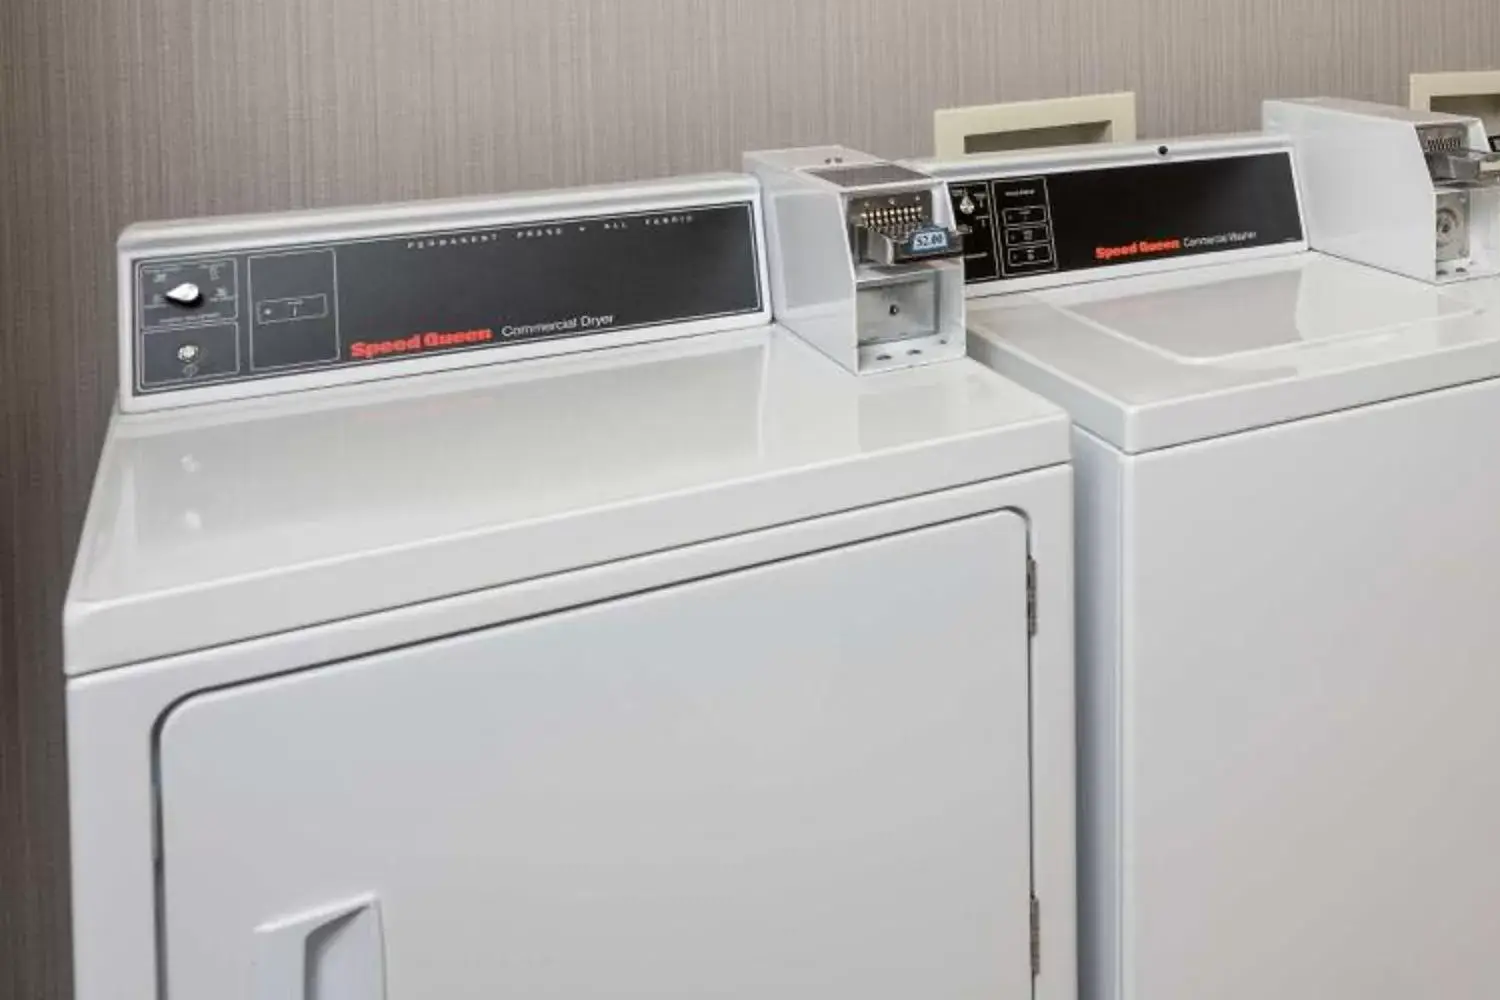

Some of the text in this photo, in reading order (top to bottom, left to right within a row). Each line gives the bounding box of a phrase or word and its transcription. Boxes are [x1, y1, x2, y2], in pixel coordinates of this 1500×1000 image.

[1095, 241, 1137, 259] Speed
[1139, 238, 1181, 254] Queen
[351, 314, 614, 359] Speed Queen Commercial Dryer
